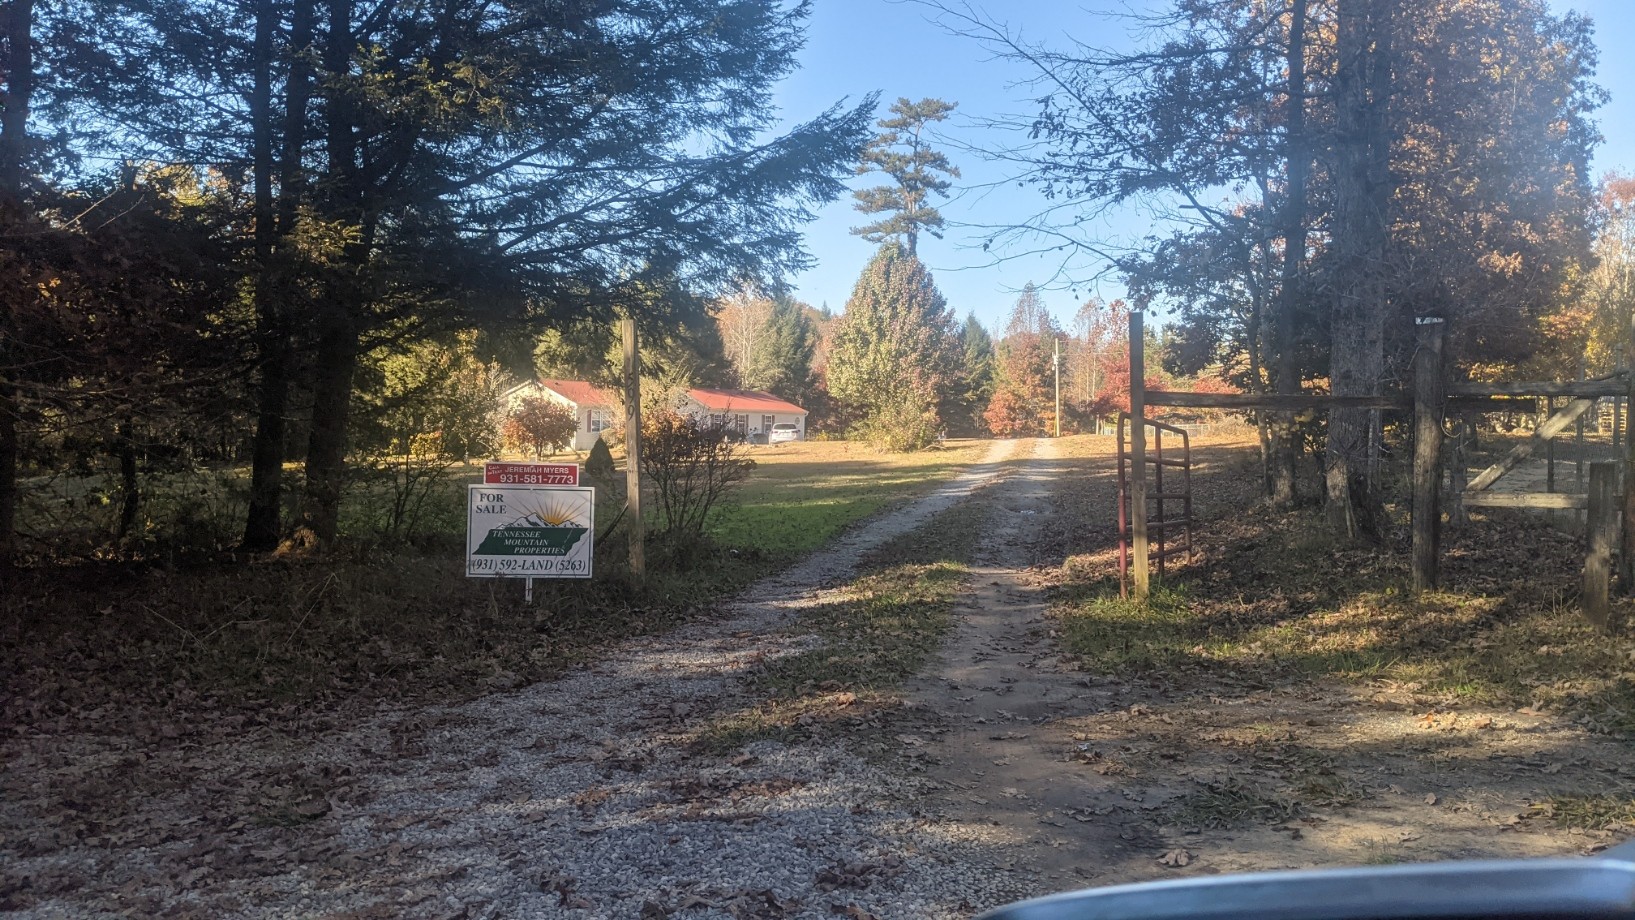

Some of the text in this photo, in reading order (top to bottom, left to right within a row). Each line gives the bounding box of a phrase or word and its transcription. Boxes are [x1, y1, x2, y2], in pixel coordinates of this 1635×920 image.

[500, 474, 574, 484] 931-581-7773
[480, 493, 504, 503] FOR
[475, 505, 507, 514] SALE
[492, 530, 541, 538] TENNESSEE
[472, 559, 586, 572] (931) 592-LAND (5263)
